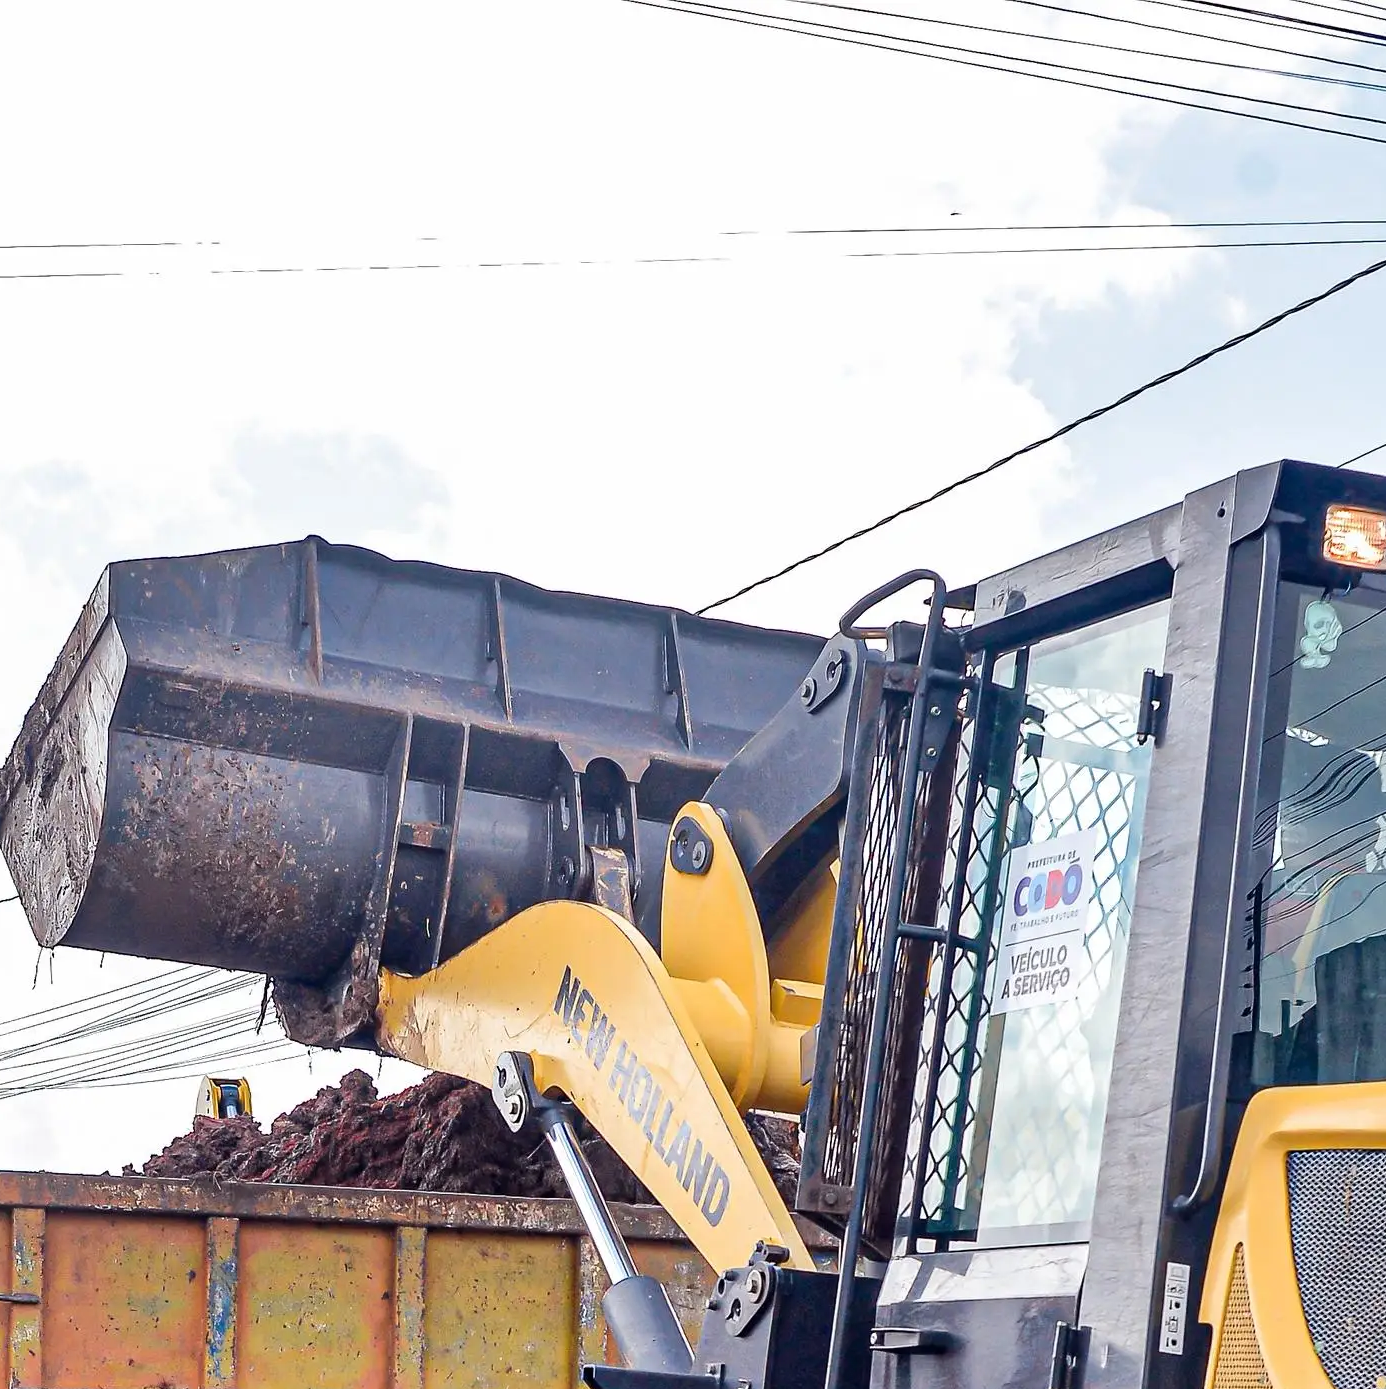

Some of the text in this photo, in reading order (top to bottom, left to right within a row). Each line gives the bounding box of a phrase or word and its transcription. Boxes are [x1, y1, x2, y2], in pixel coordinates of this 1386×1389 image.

[1027, 854, 1066, 870] PREFEITURA
[1011, 944, 1068, 975] VEÍCULO
[1001, 966, 1070, 1000] A SERVIÇO
[553, 964, 731, 1228] NEW HOLLAND
